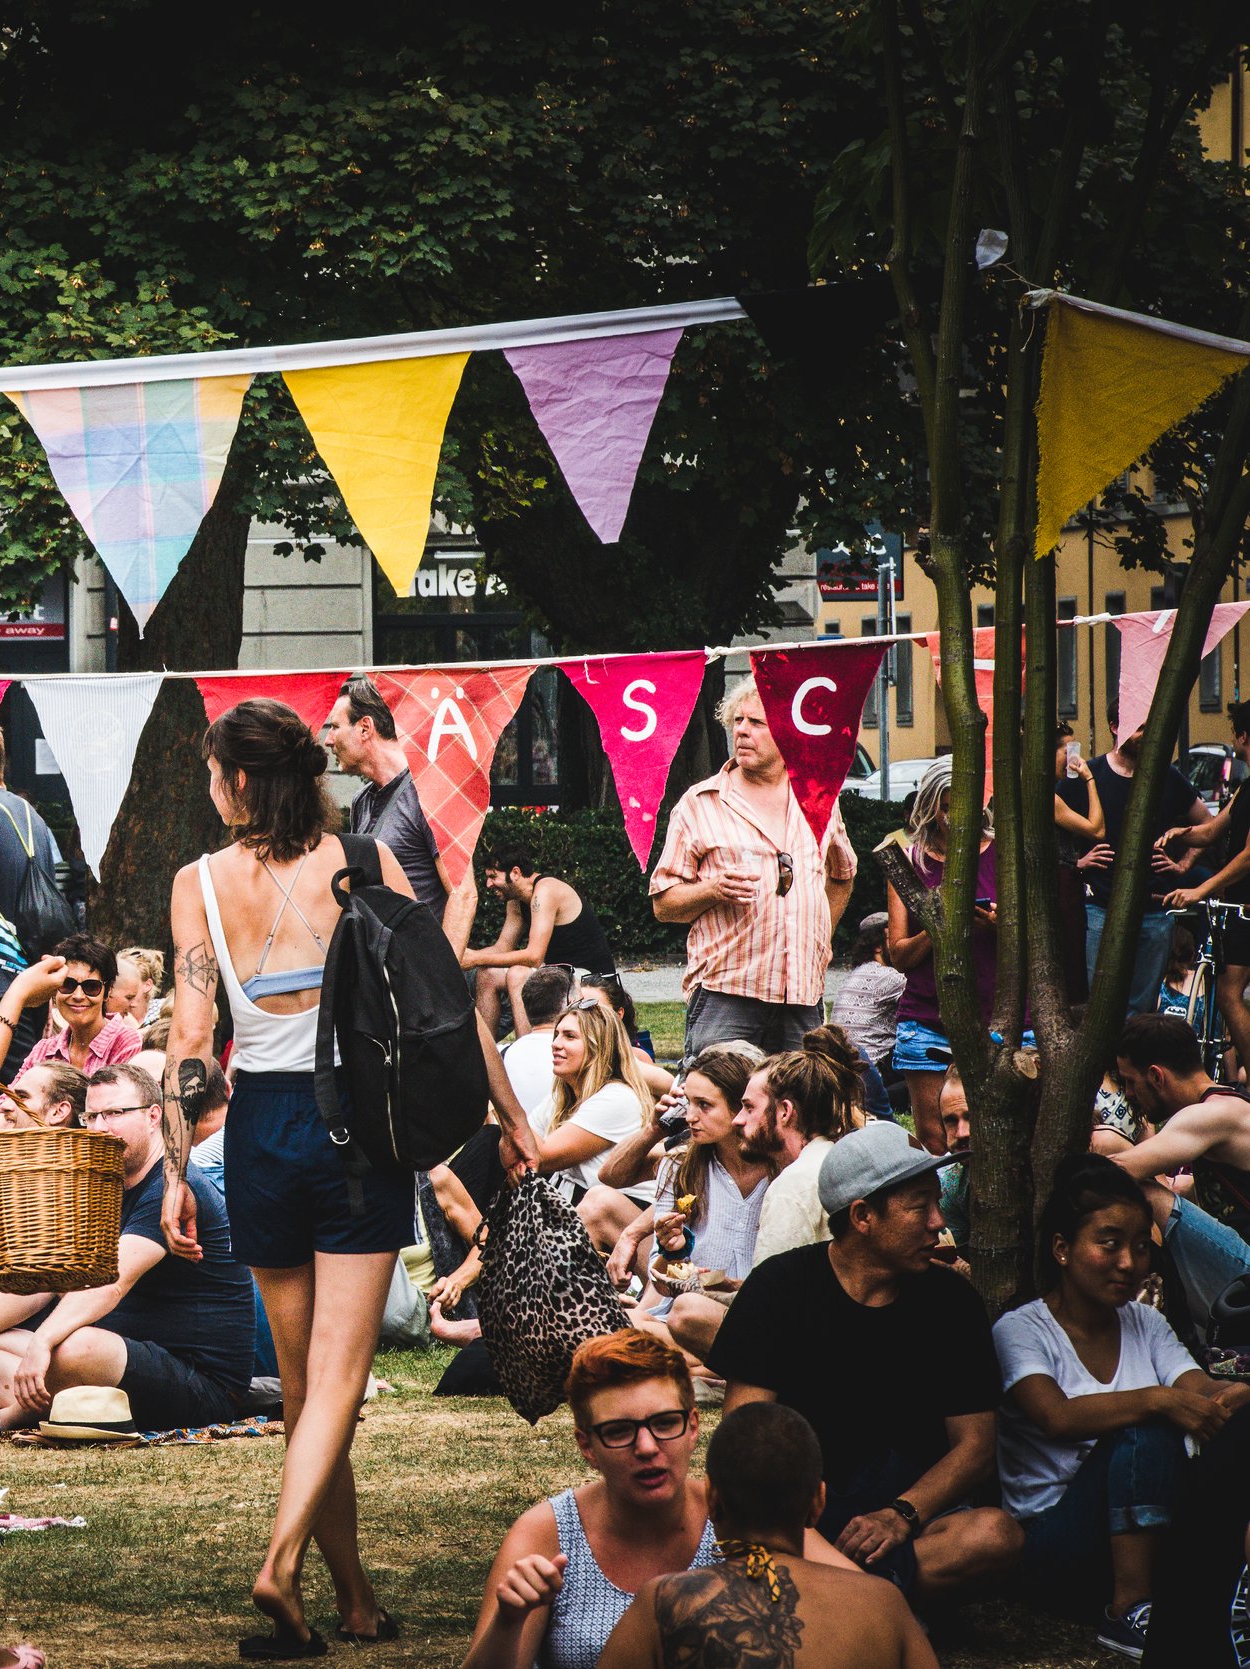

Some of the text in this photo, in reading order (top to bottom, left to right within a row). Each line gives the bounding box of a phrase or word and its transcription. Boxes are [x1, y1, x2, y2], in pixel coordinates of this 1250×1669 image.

[409, 563, 477, 597] ake
[5, 626, 46, 637] away
[427, 686, 478, 763] Ä
[620, 679, 658, 742] S
[791, 676, 837, 737] C
